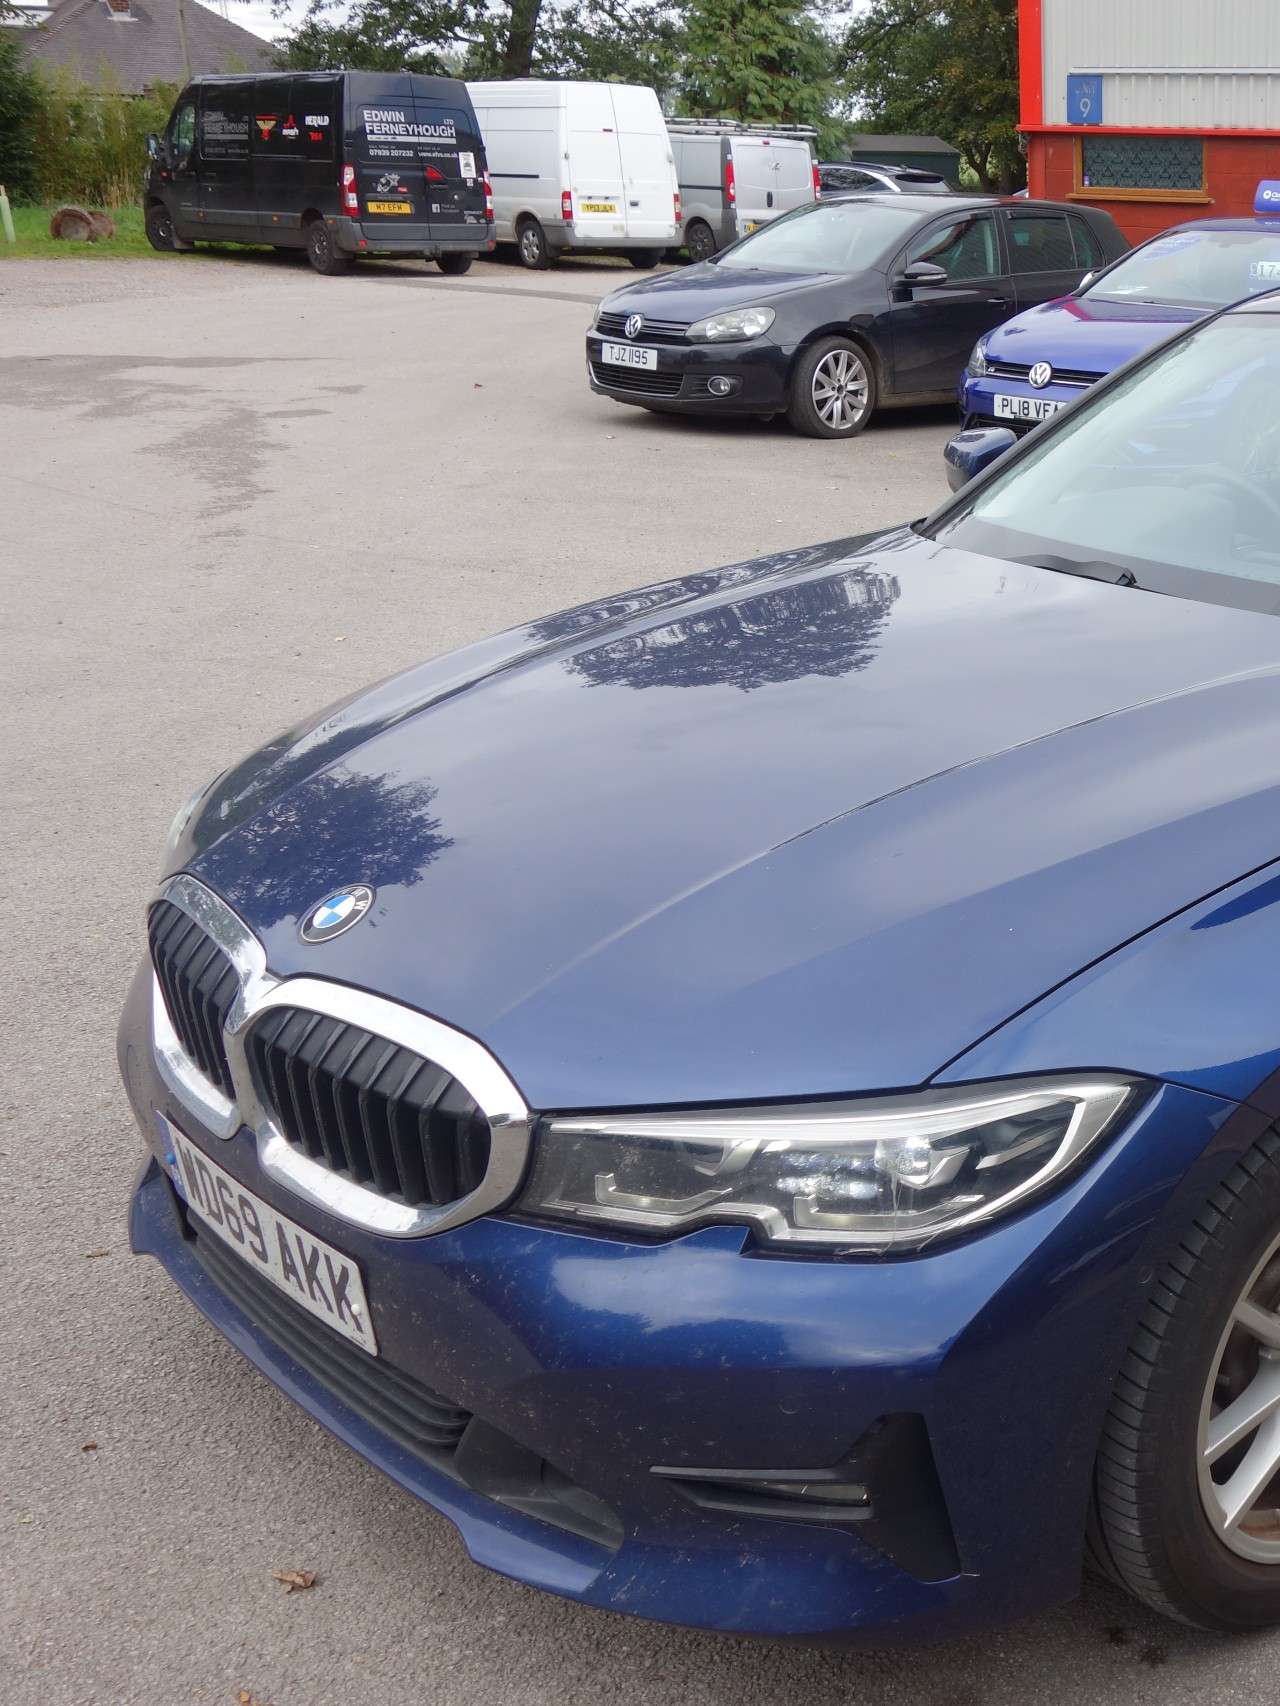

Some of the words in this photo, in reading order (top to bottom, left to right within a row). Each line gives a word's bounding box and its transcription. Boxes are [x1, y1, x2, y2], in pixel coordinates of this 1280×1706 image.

[305, 115, 330, 128] HERALD
[363, 110, 405, 122] EDWIN
[365, 123, 456, 137] FERNEYHOUGH
[610, 345, 627, 362] TJZ
[628, 348, 648, 365] 1195
[1001, 397, 1030, 416] PL18
[275, 1220, 364, 1333] AKK
